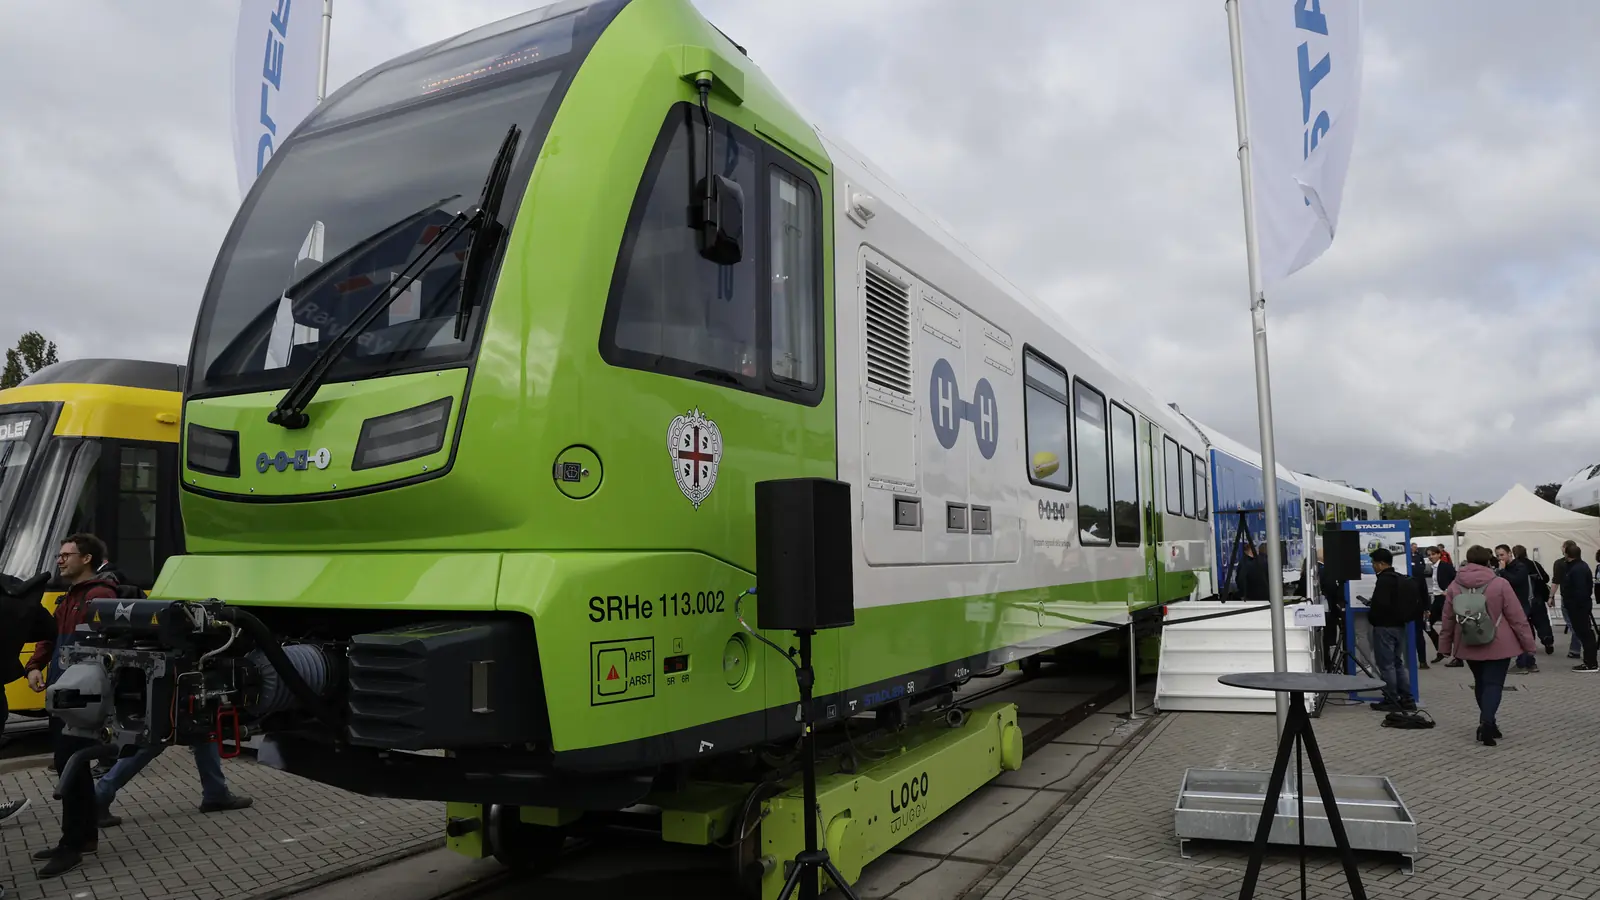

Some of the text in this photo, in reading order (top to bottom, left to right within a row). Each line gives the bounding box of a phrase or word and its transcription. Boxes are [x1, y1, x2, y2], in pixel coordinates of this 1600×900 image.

[938, 377, 993, 442] H H
[588, 590, 725, 622] SRHe 113.002
[629, 650, 652, 662] ARST
[629, 674, 652, 687] ARST
[863, 681, 916, 706] STADLER 5R
[890, 771, 929, 814] LOCO
